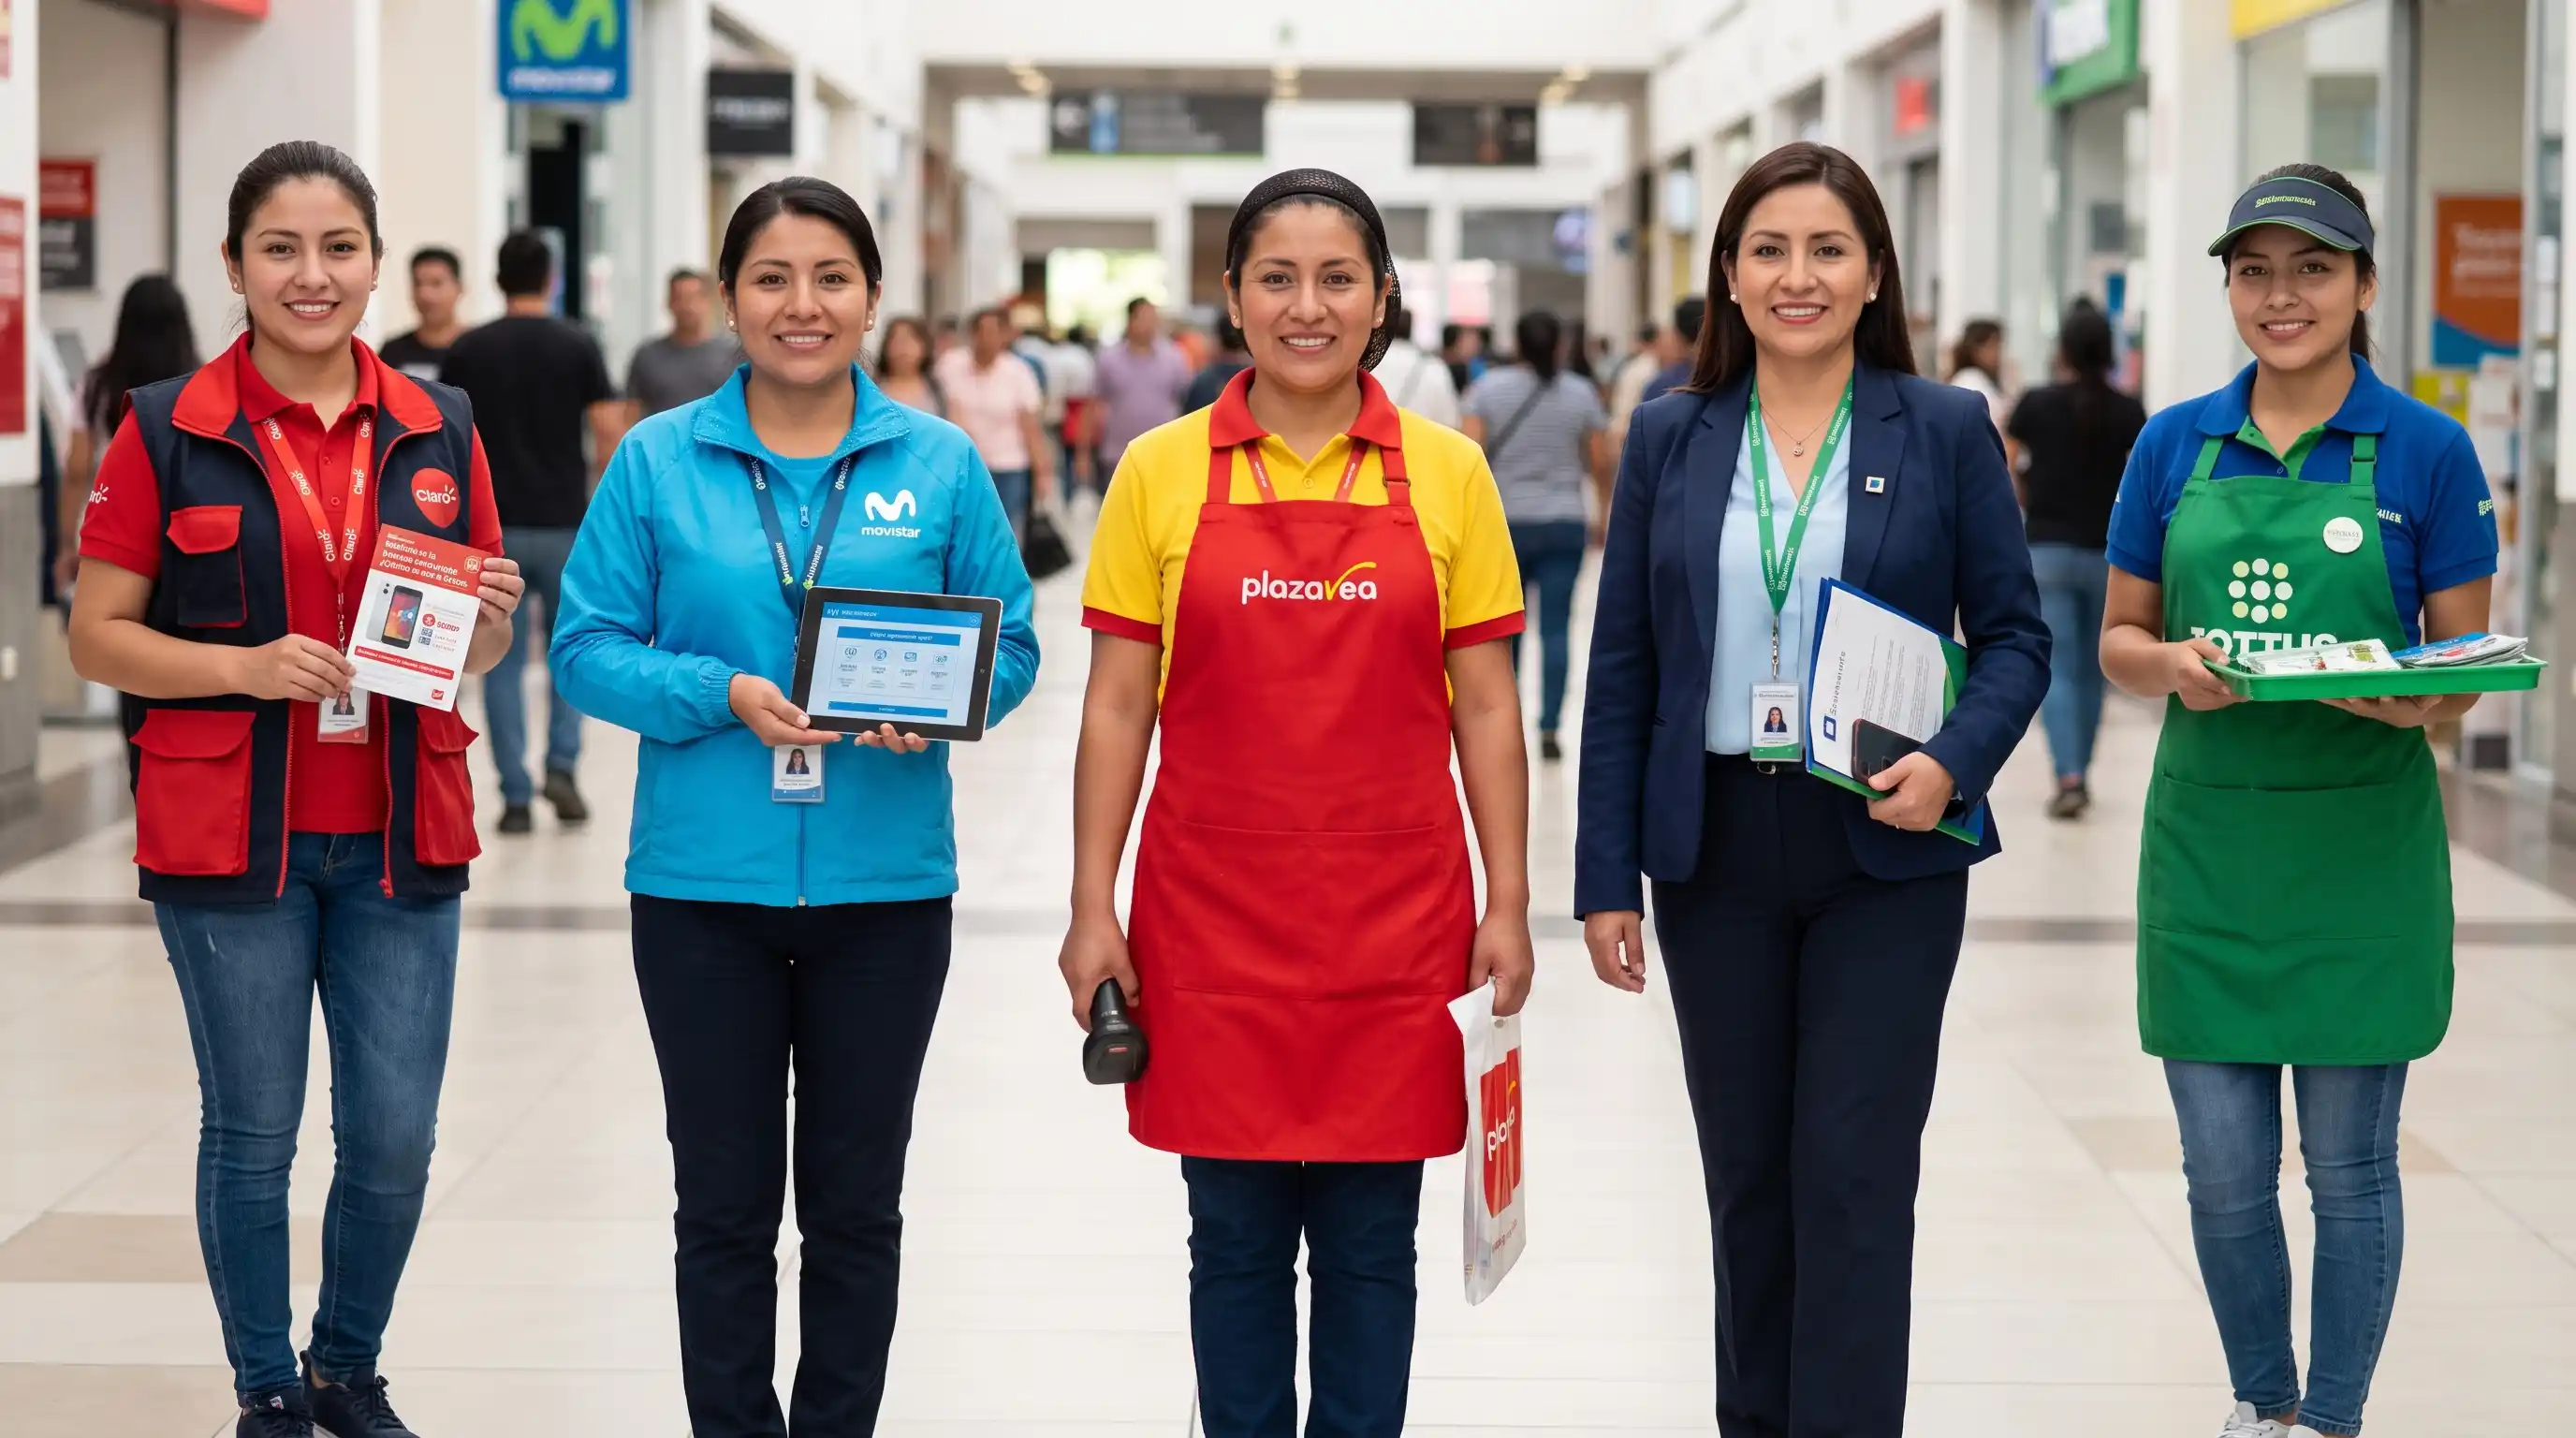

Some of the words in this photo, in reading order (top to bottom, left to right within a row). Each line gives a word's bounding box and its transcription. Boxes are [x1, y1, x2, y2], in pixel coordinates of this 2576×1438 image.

[416, 486, 453, 505] Claro
[861, 526, 921, 538] movistar
[1241, 562, 1377, 605] plazavea
